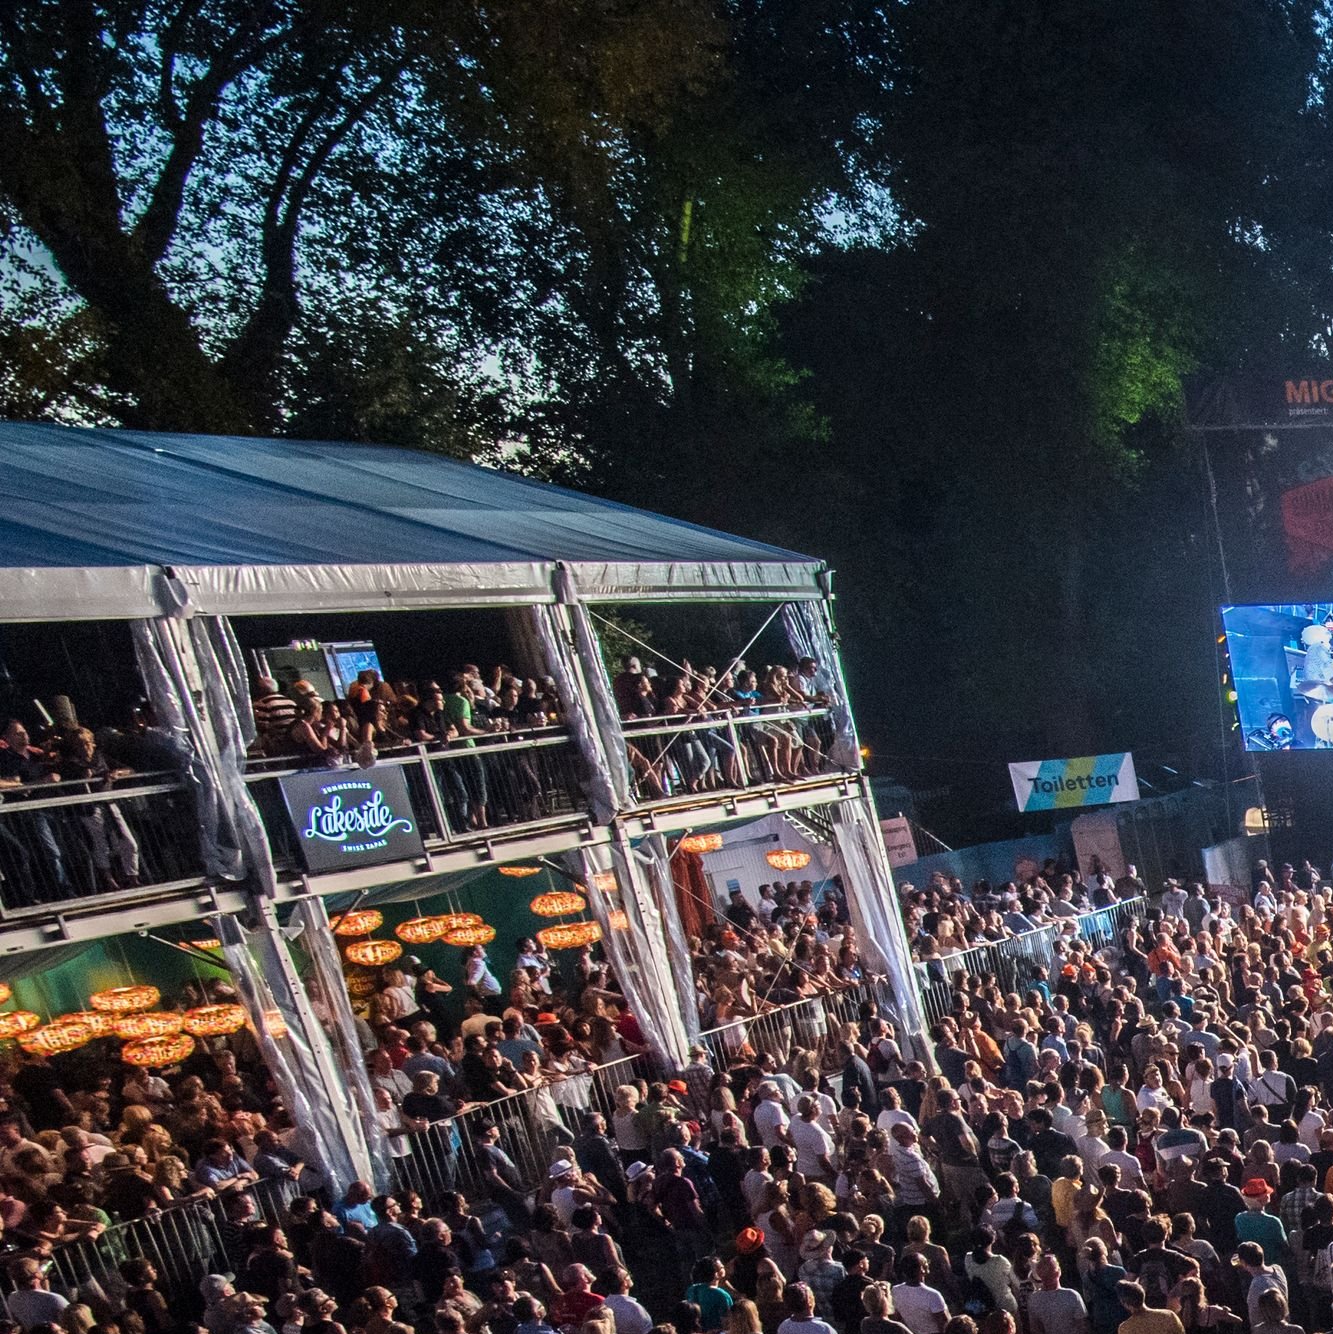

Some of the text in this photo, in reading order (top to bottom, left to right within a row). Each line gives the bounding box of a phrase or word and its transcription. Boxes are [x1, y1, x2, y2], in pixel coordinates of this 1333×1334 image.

[322, 782, 373, 794] SUMMERDAYS
[1027, 773, 1119, 793] Toiletten
[304, 791, 413, 841] Lakeside
